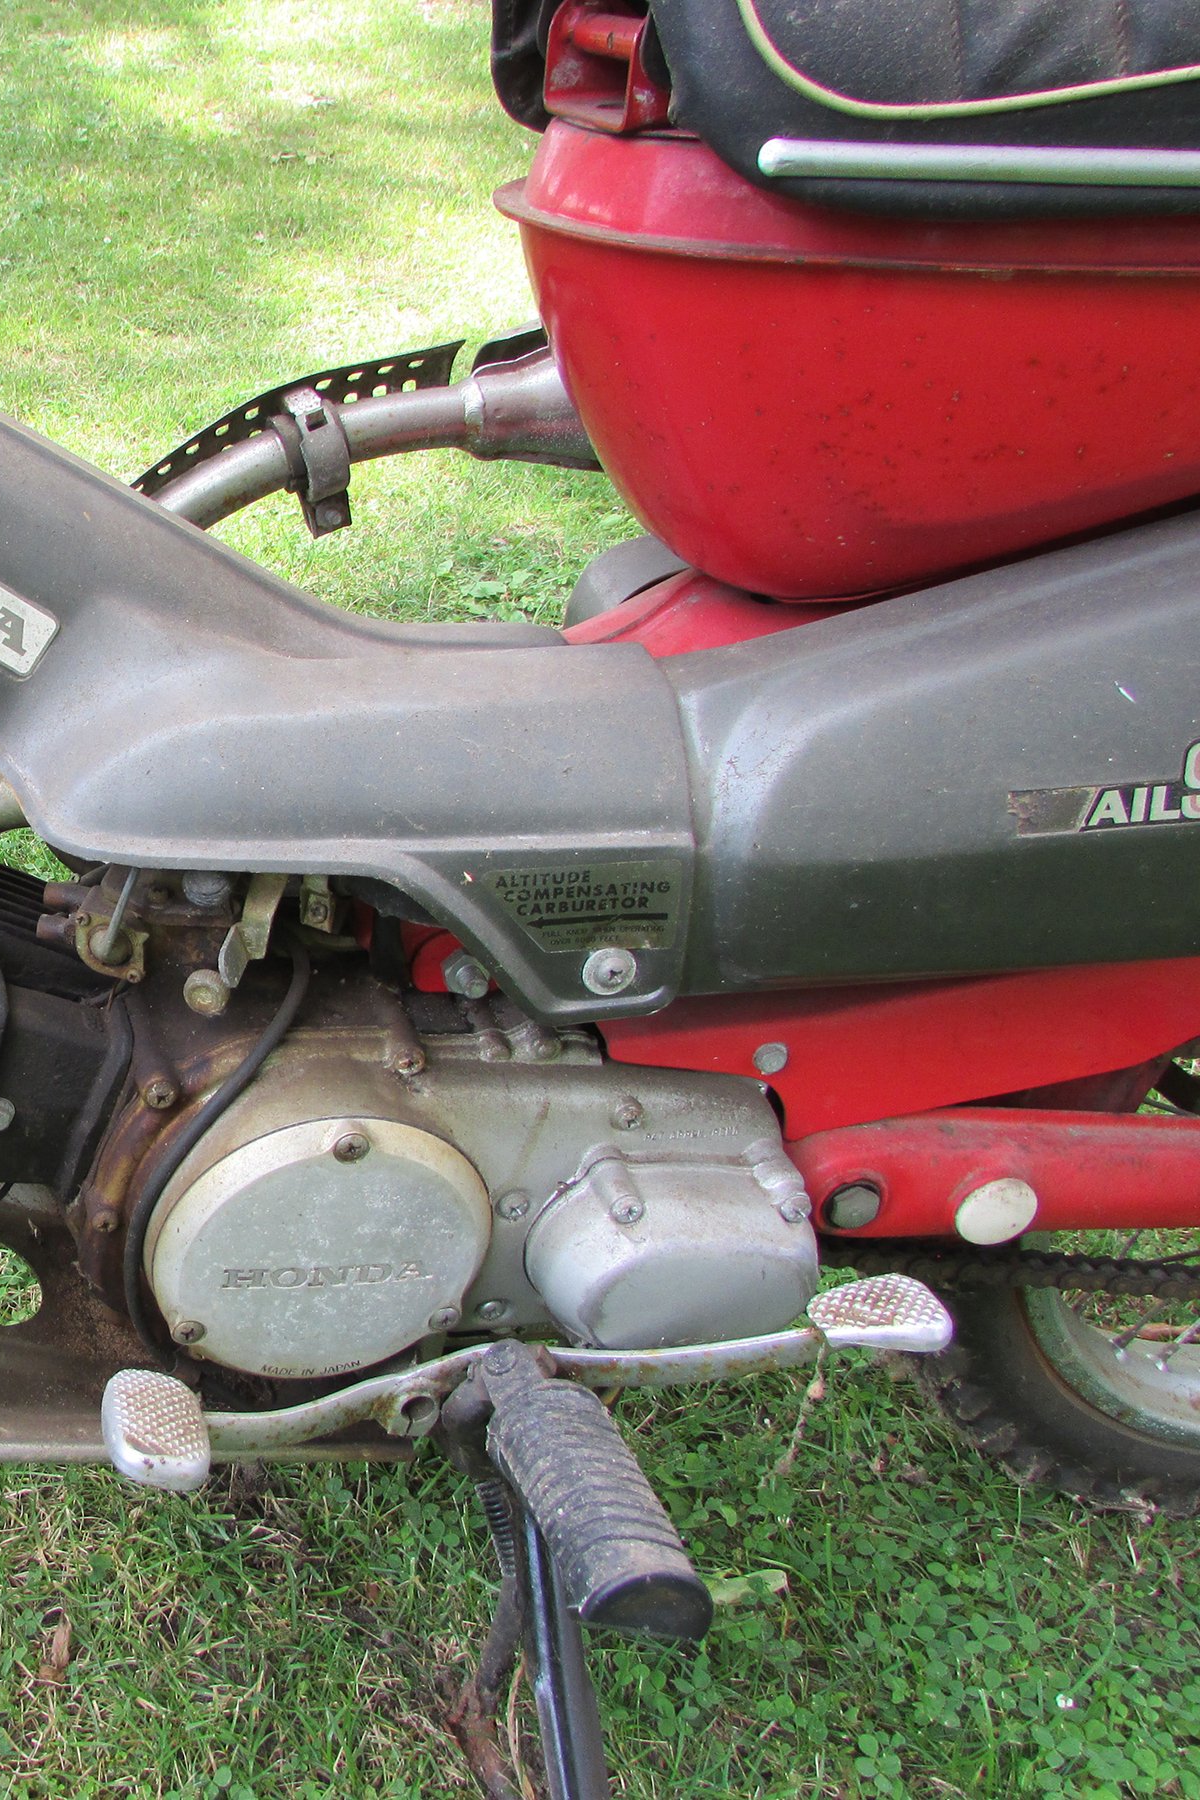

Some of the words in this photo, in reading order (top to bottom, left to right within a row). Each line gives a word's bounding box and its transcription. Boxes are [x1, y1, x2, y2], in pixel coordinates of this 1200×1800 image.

[495, 870, 591, 889] ALTITUDE
[503, 880, 671, 903] COMPENSATING
[516, 896, 650, 917] CARBURETOR
[220, 1260, 433, 1291] HONDA
[260, 1364, 297, 1376] MADE
[301, 1368, 315, 1376] IN
[320, 1360, 360, 1375] JAPAN
